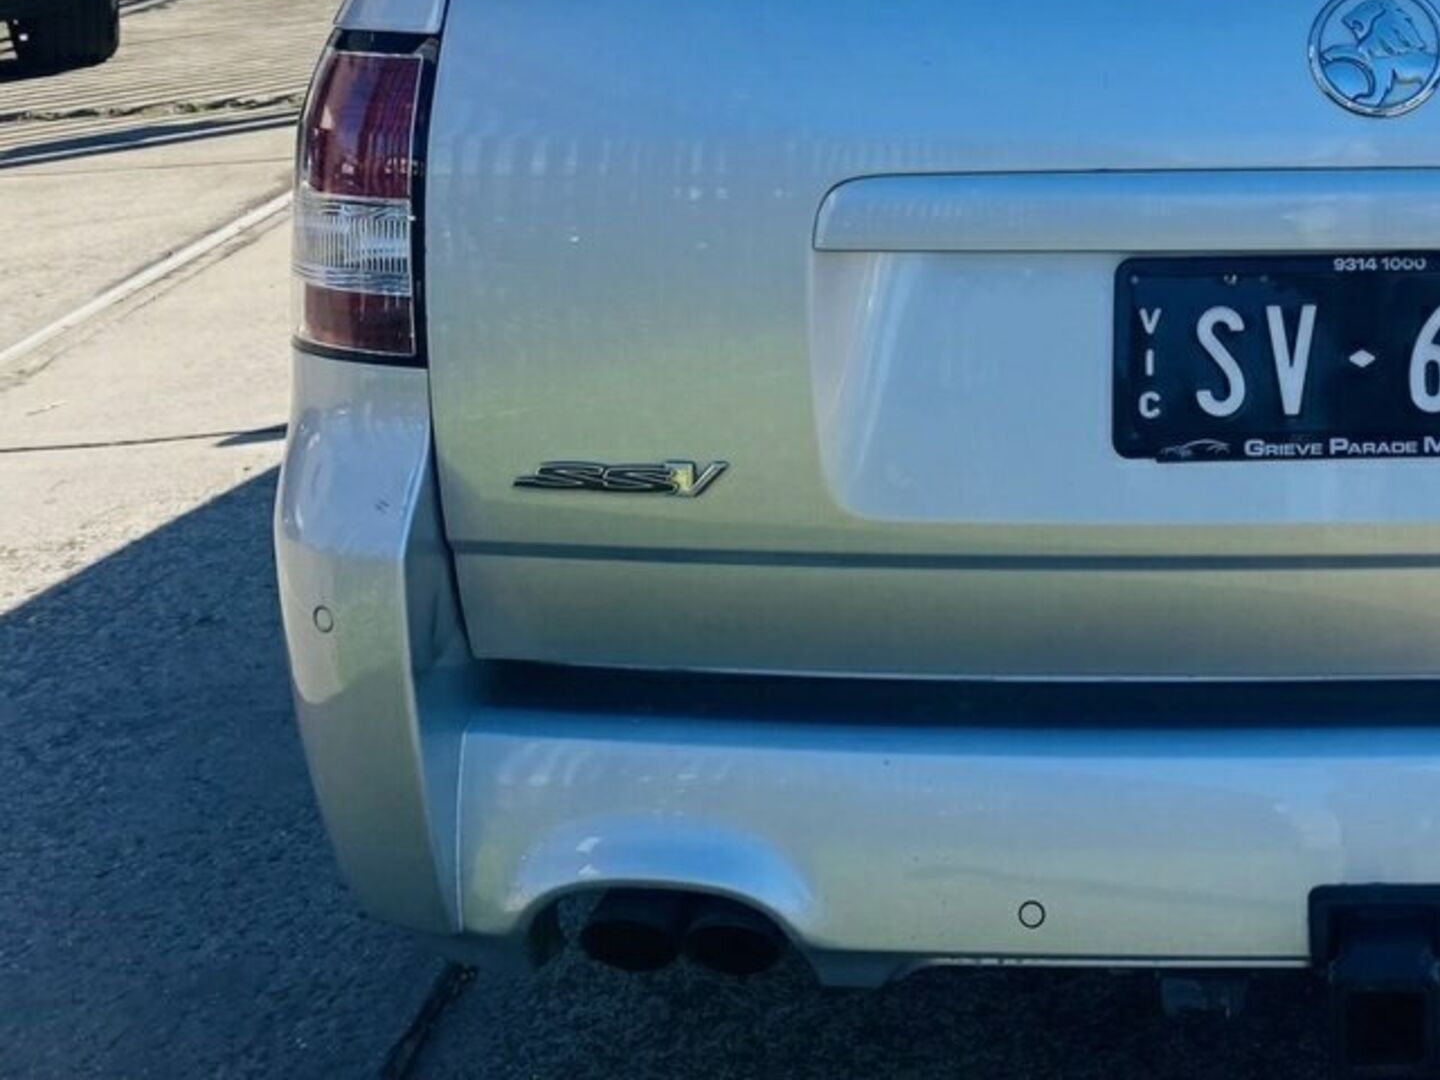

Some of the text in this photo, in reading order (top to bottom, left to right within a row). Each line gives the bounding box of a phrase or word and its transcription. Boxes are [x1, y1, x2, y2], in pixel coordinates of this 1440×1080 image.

[1333, 256, 1427, 272] 9314 1000
[1139, 307, 1162, 420] VIC
[1243, 438, 1324, 457] GRIEVE
[1328, 437, 1418, 455] PARADE
